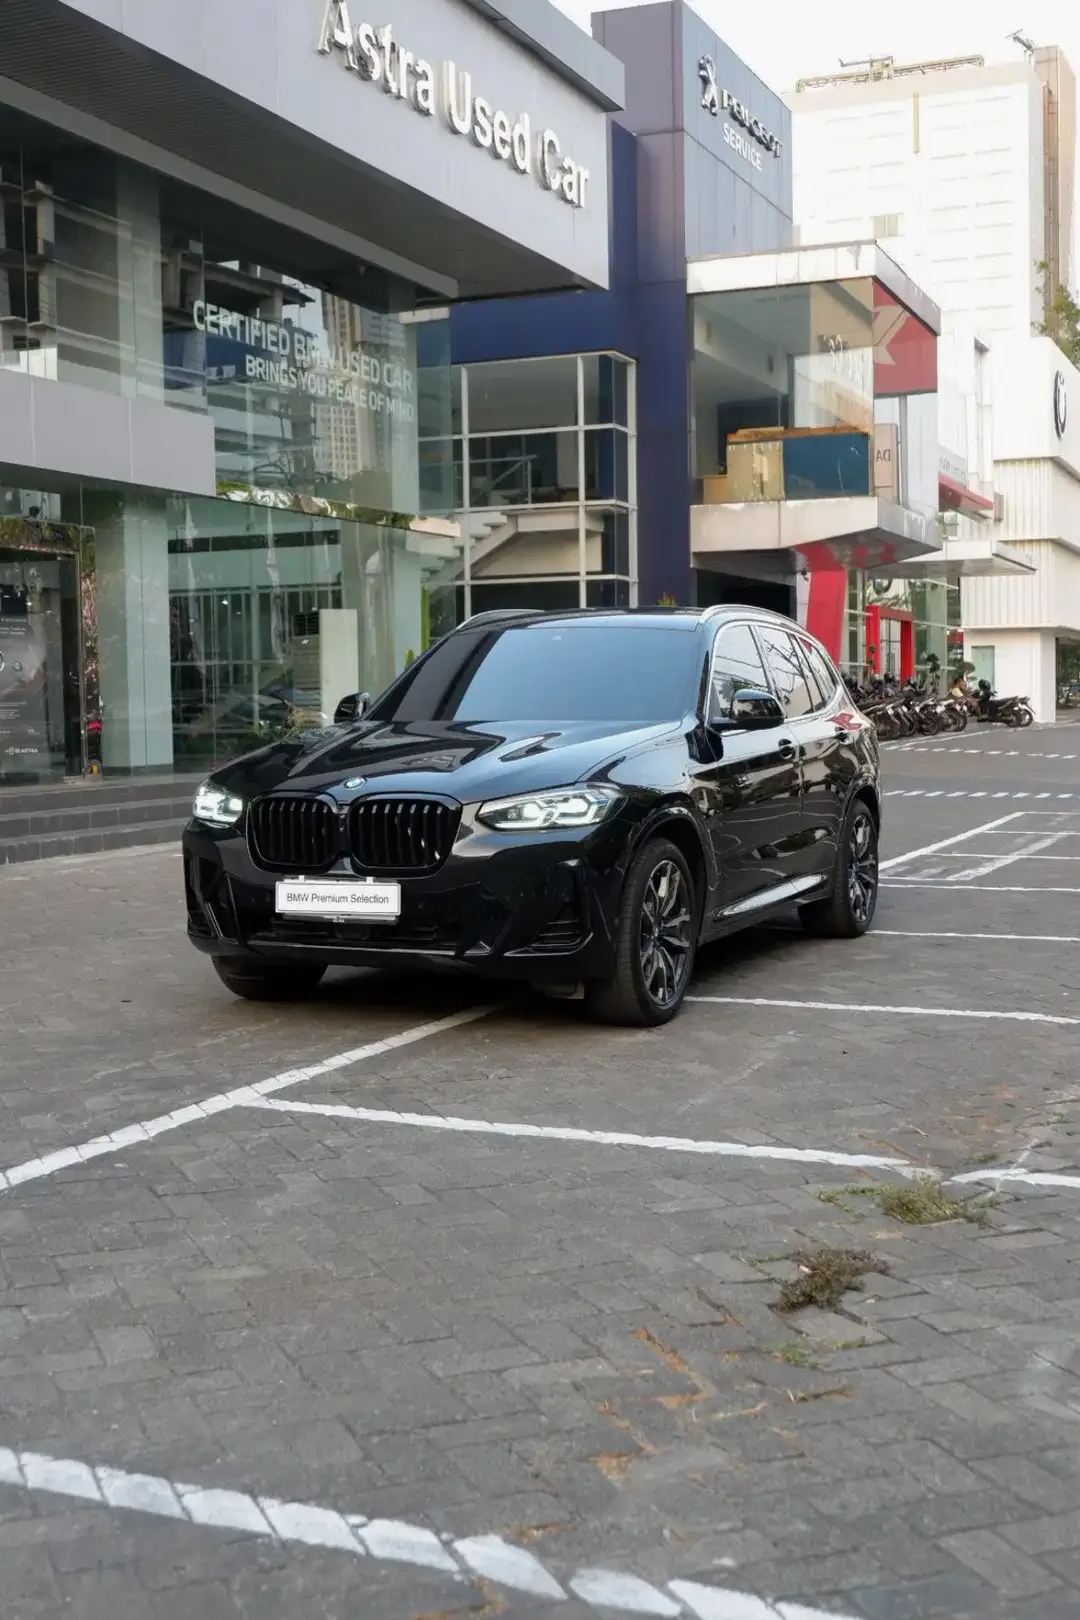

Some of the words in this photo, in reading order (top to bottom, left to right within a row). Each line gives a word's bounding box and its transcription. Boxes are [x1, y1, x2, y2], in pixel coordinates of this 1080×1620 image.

[318, 0, 435, 116] Astra
[443, 60, 530, 174] Used
[539, 128, 590, 208] Car
[722, 122, 762, 172] SERVICE
[193, 300, 290, 356] CERTIFIED
[383, 361, 413, 394] CAR
[245, 354, 297, 388] BRINGS
[299, 371, 327, 397] YOU
[369, 390, 385, 412] OF
[386, 397, 414, 421] MIND
[286, 893, 309, 902] BMW
[311, 893, 348, 903] Premium
[350, 894, 389, 904] Selection
